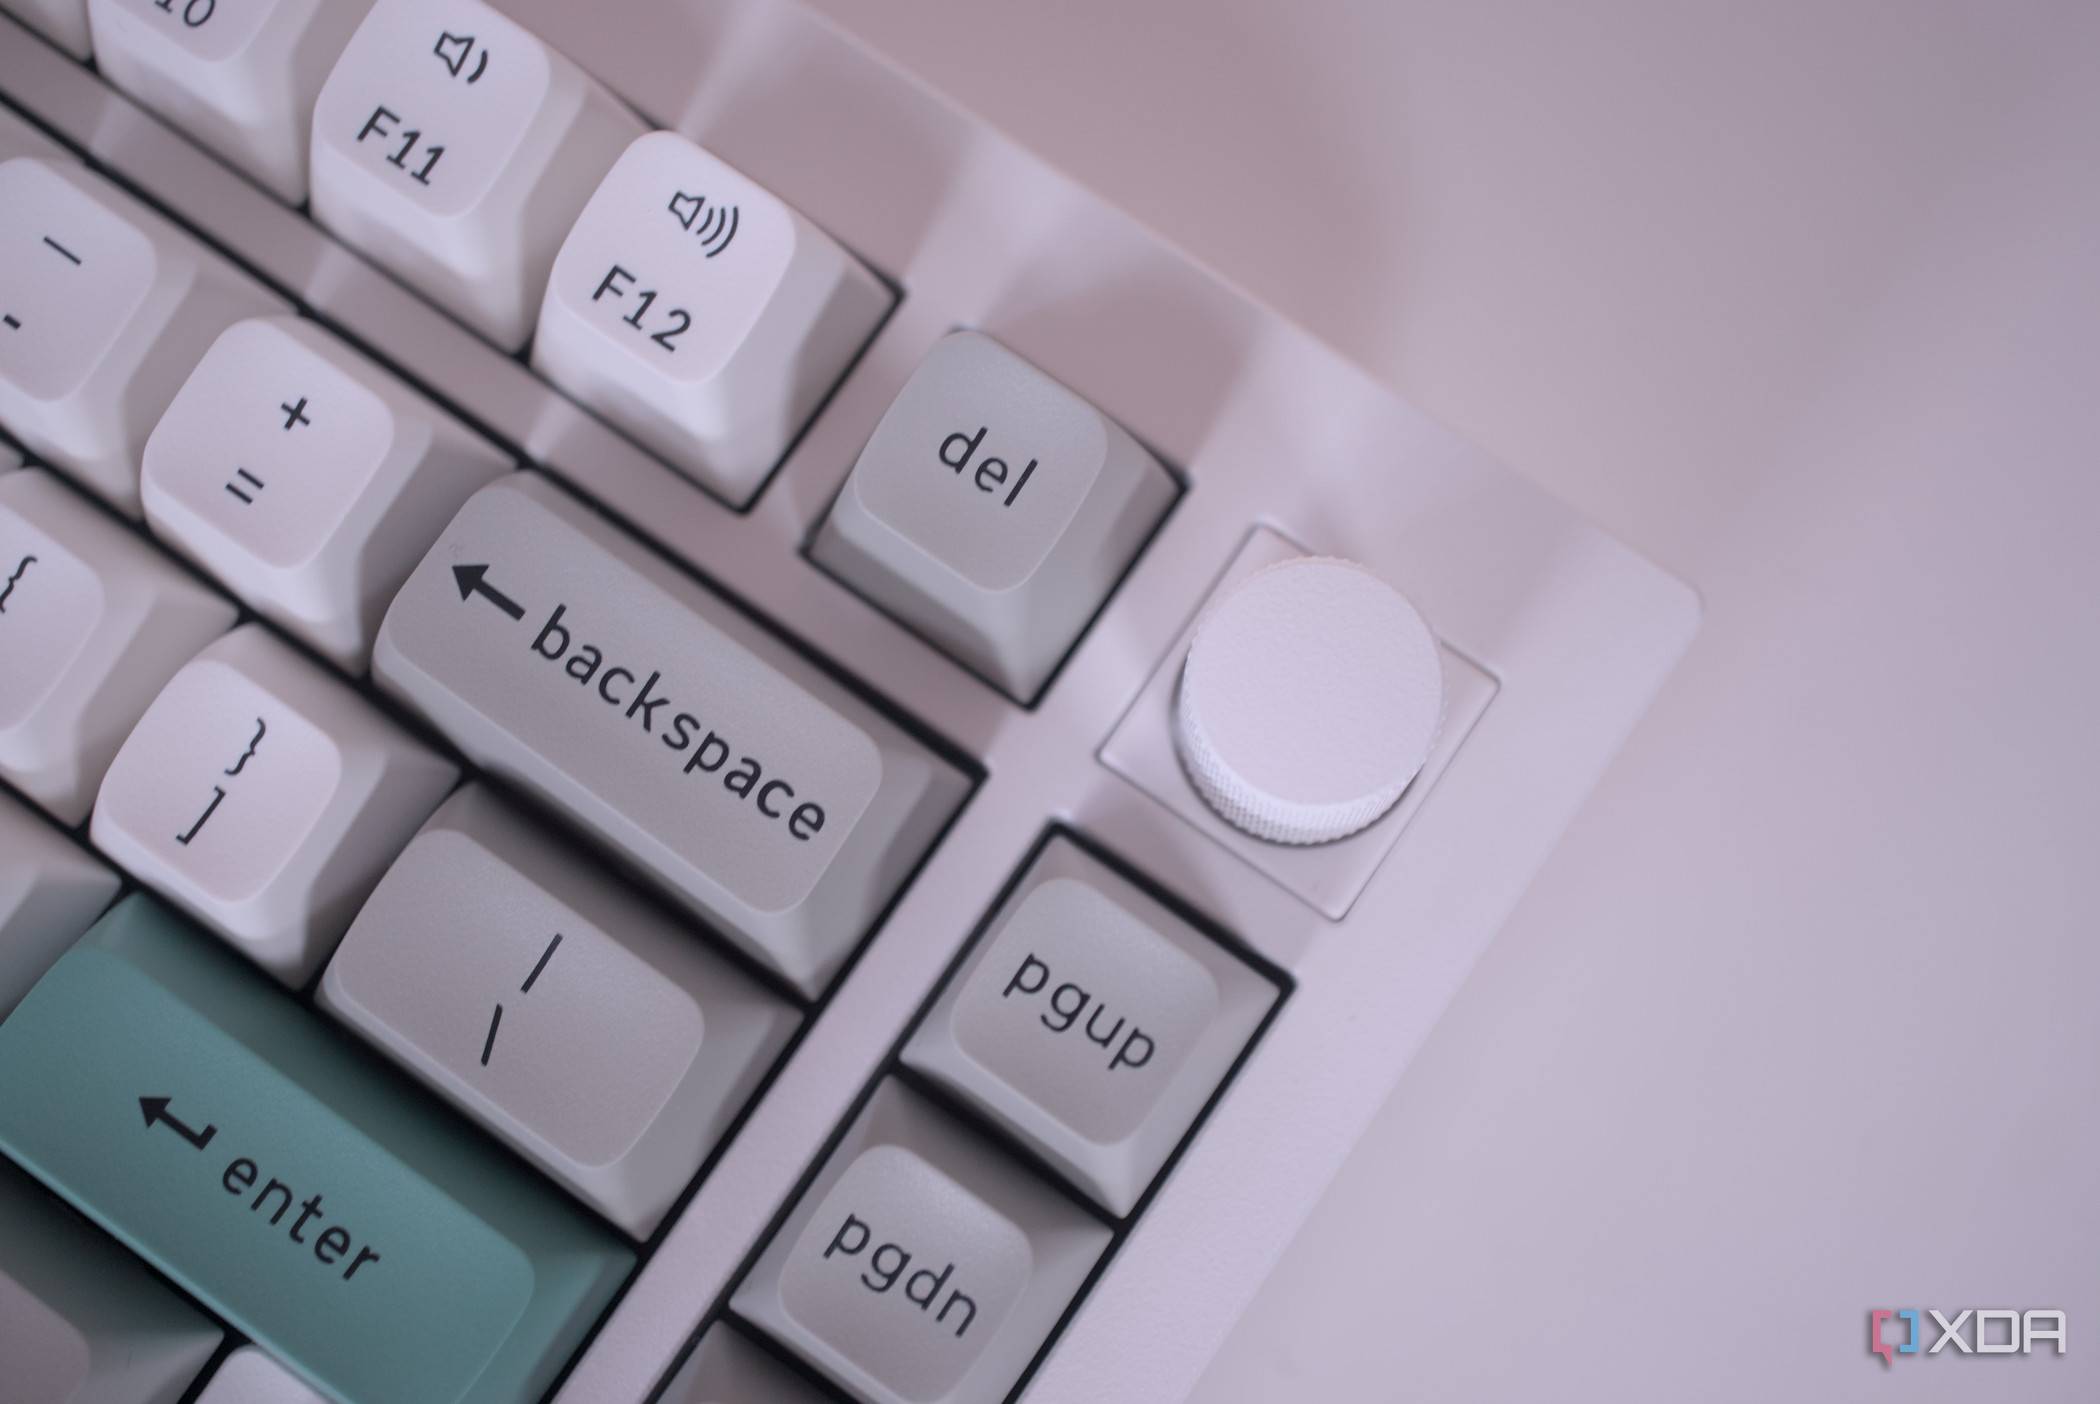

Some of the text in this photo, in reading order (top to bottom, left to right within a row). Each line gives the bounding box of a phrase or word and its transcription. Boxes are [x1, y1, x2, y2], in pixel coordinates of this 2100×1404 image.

[357, 106, 445, 186] F11
[592, 264, 691, 352] F12
[281, 397, 310, 431] +
[225, 468, 264, 505] =
[939, 426, 1038, 507] del
[224, 717, 266, 776] }
[531, 604, 825, 841] backspace
[176, 785, 226, 846] ]
[520, 934, 563, 994] |
[1003, 953, 1155, 1070] pgup
[223, 1158, 379, 1280] enter
[823, 1214, 976, 1337] pgdn
